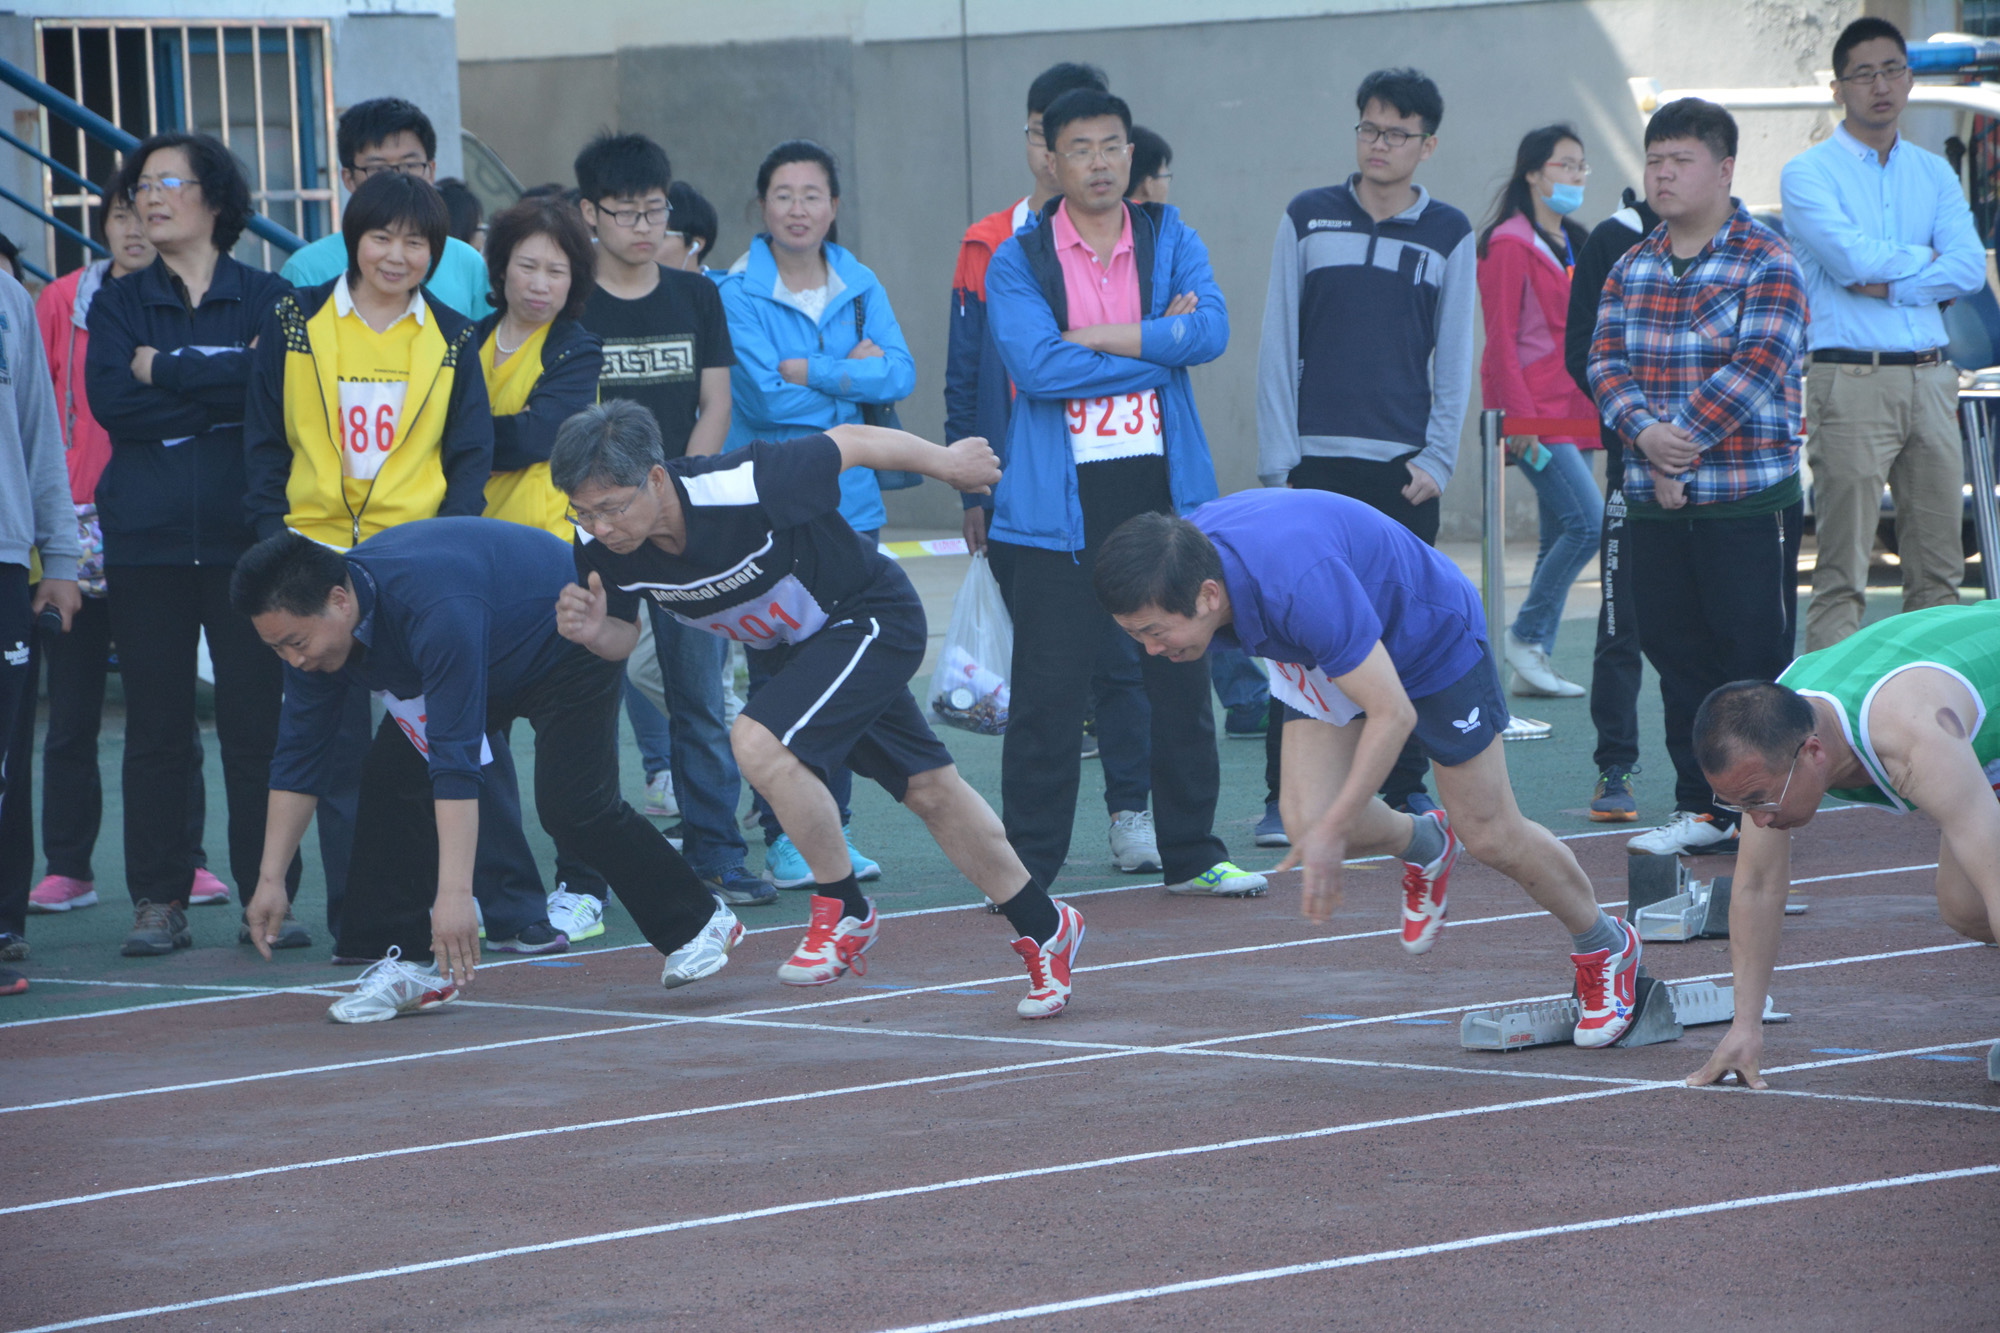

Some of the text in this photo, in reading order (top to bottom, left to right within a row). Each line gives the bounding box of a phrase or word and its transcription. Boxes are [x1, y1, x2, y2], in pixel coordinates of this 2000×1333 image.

[338, 403, 395, 453] 86
[715, 561, 764, 593] sport
[710, 601, 802, 643] 201
